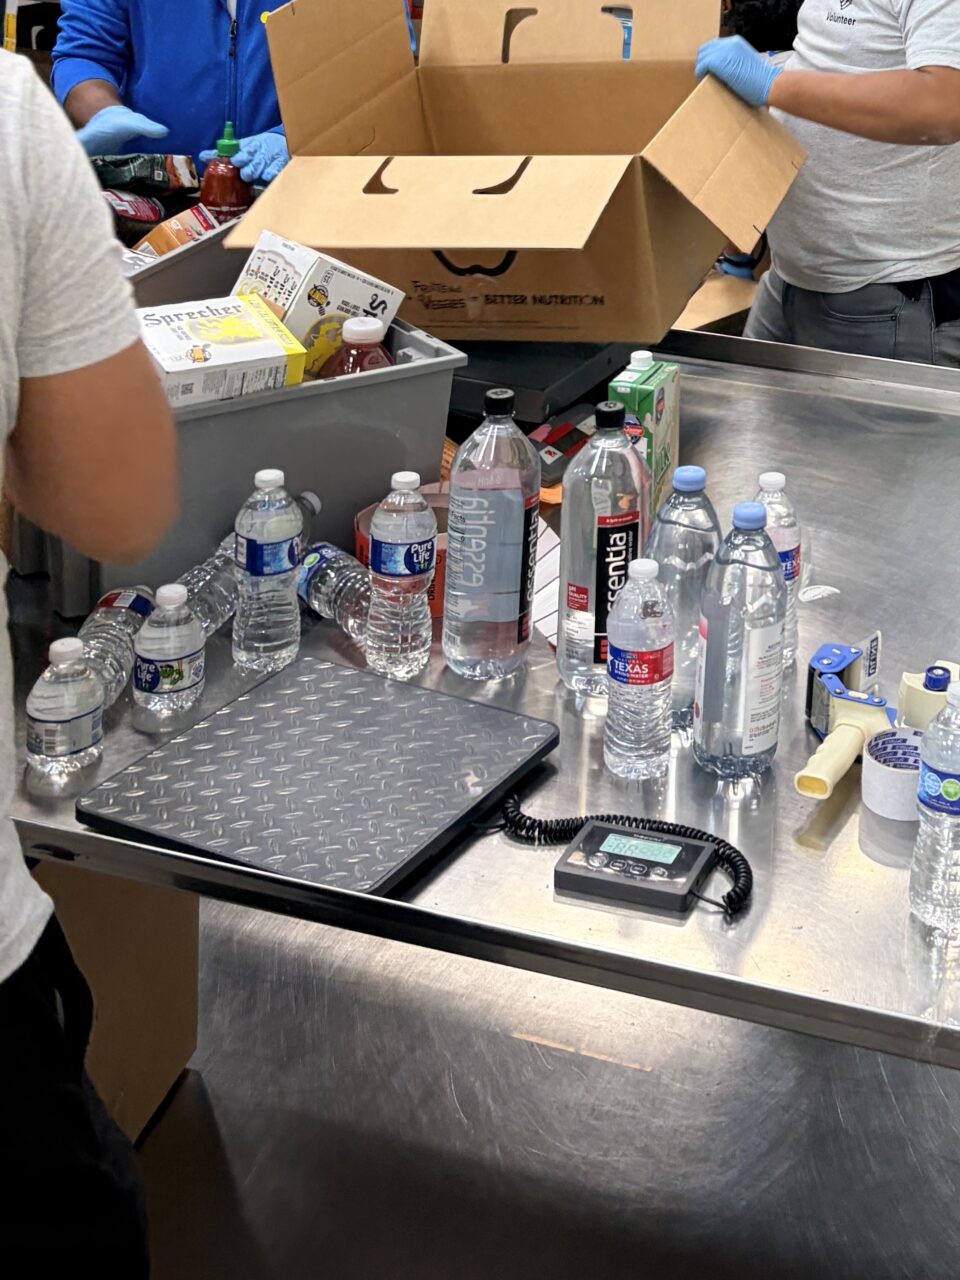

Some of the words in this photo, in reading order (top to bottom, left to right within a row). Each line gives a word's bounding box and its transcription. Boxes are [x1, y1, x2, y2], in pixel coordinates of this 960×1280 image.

[826, 11, 857, 26] Volunteer
[484, 294, 527, 305] BETTER
[532, 294, 605, 306] NUTRITION
[143, 304, 243, 328] Sprecher
[411, 541, 433, 554] Pure
[413, 551, 430, 564] Life
[604, 531, 627, 612] ssentia
[136, 658, 156, 672] Pure
[613, 660, 649, 674] TEXAS
[137, 671, 153, 683] Life
